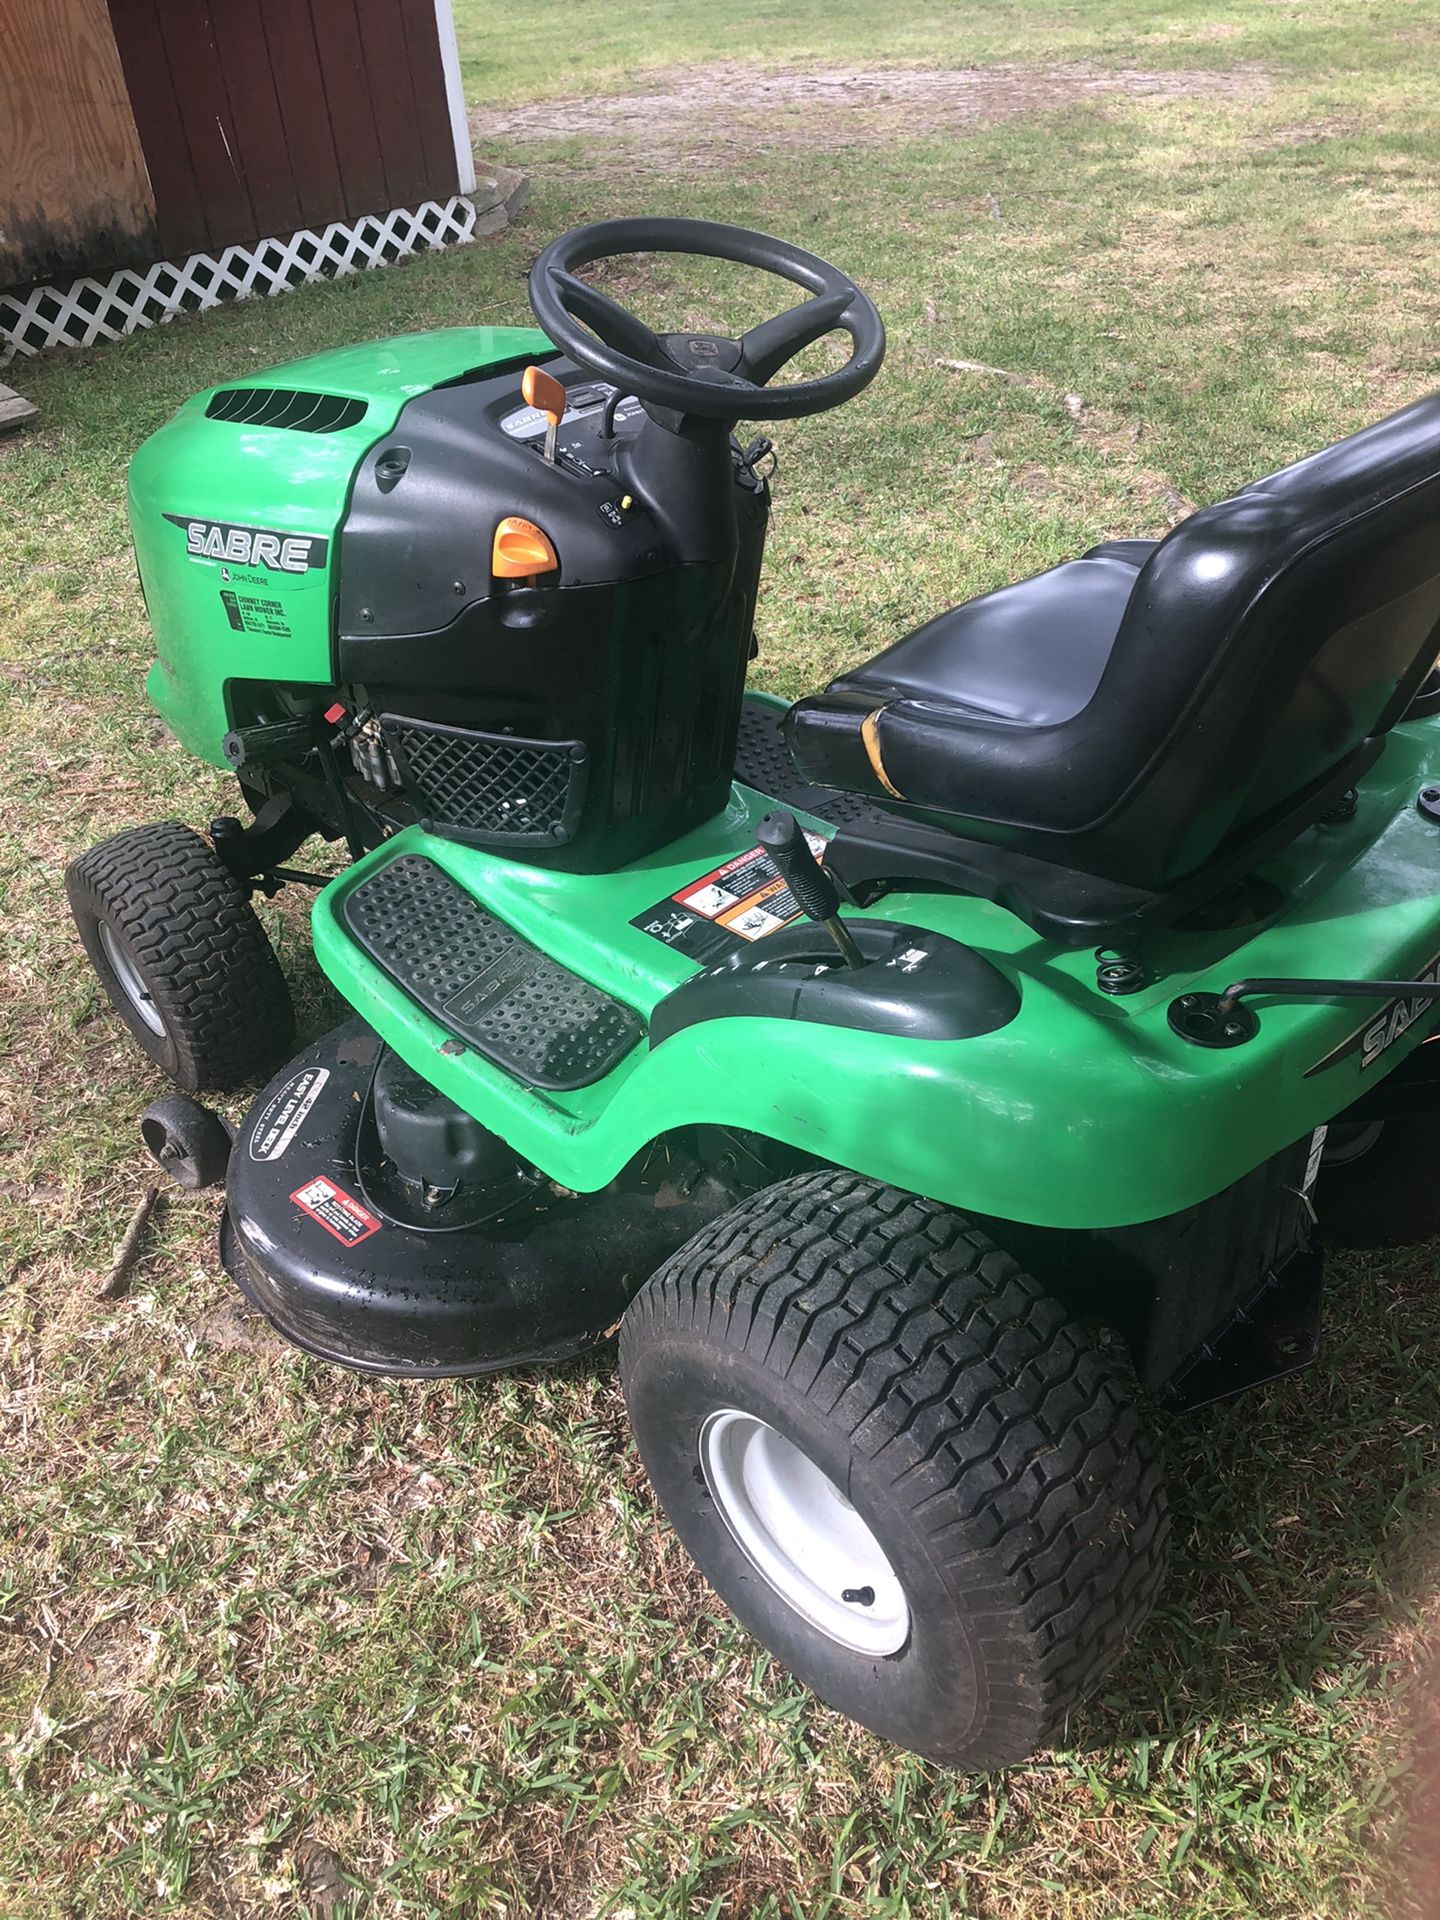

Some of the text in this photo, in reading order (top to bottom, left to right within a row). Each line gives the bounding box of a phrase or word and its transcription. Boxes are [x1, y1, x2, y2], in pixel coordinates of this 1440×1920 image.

[187, 522, 312, 573] SABRE
[231, 573, 269, 586] JOHN DEERE
[240, 603, 254, 612] LAWN
[254, 605, 274, 615] MOWER
[260, 599, 282, 609] CORNER
[727, 847, 764, 870] DANGER
[460, 960, 526, 1015] SABRE
[258, 1073, 314, 1154] EASY LEVEL DECK
[289, 1097, 313, 1129] 42 inch
[348, 1202, 370, 1221] DANGER
